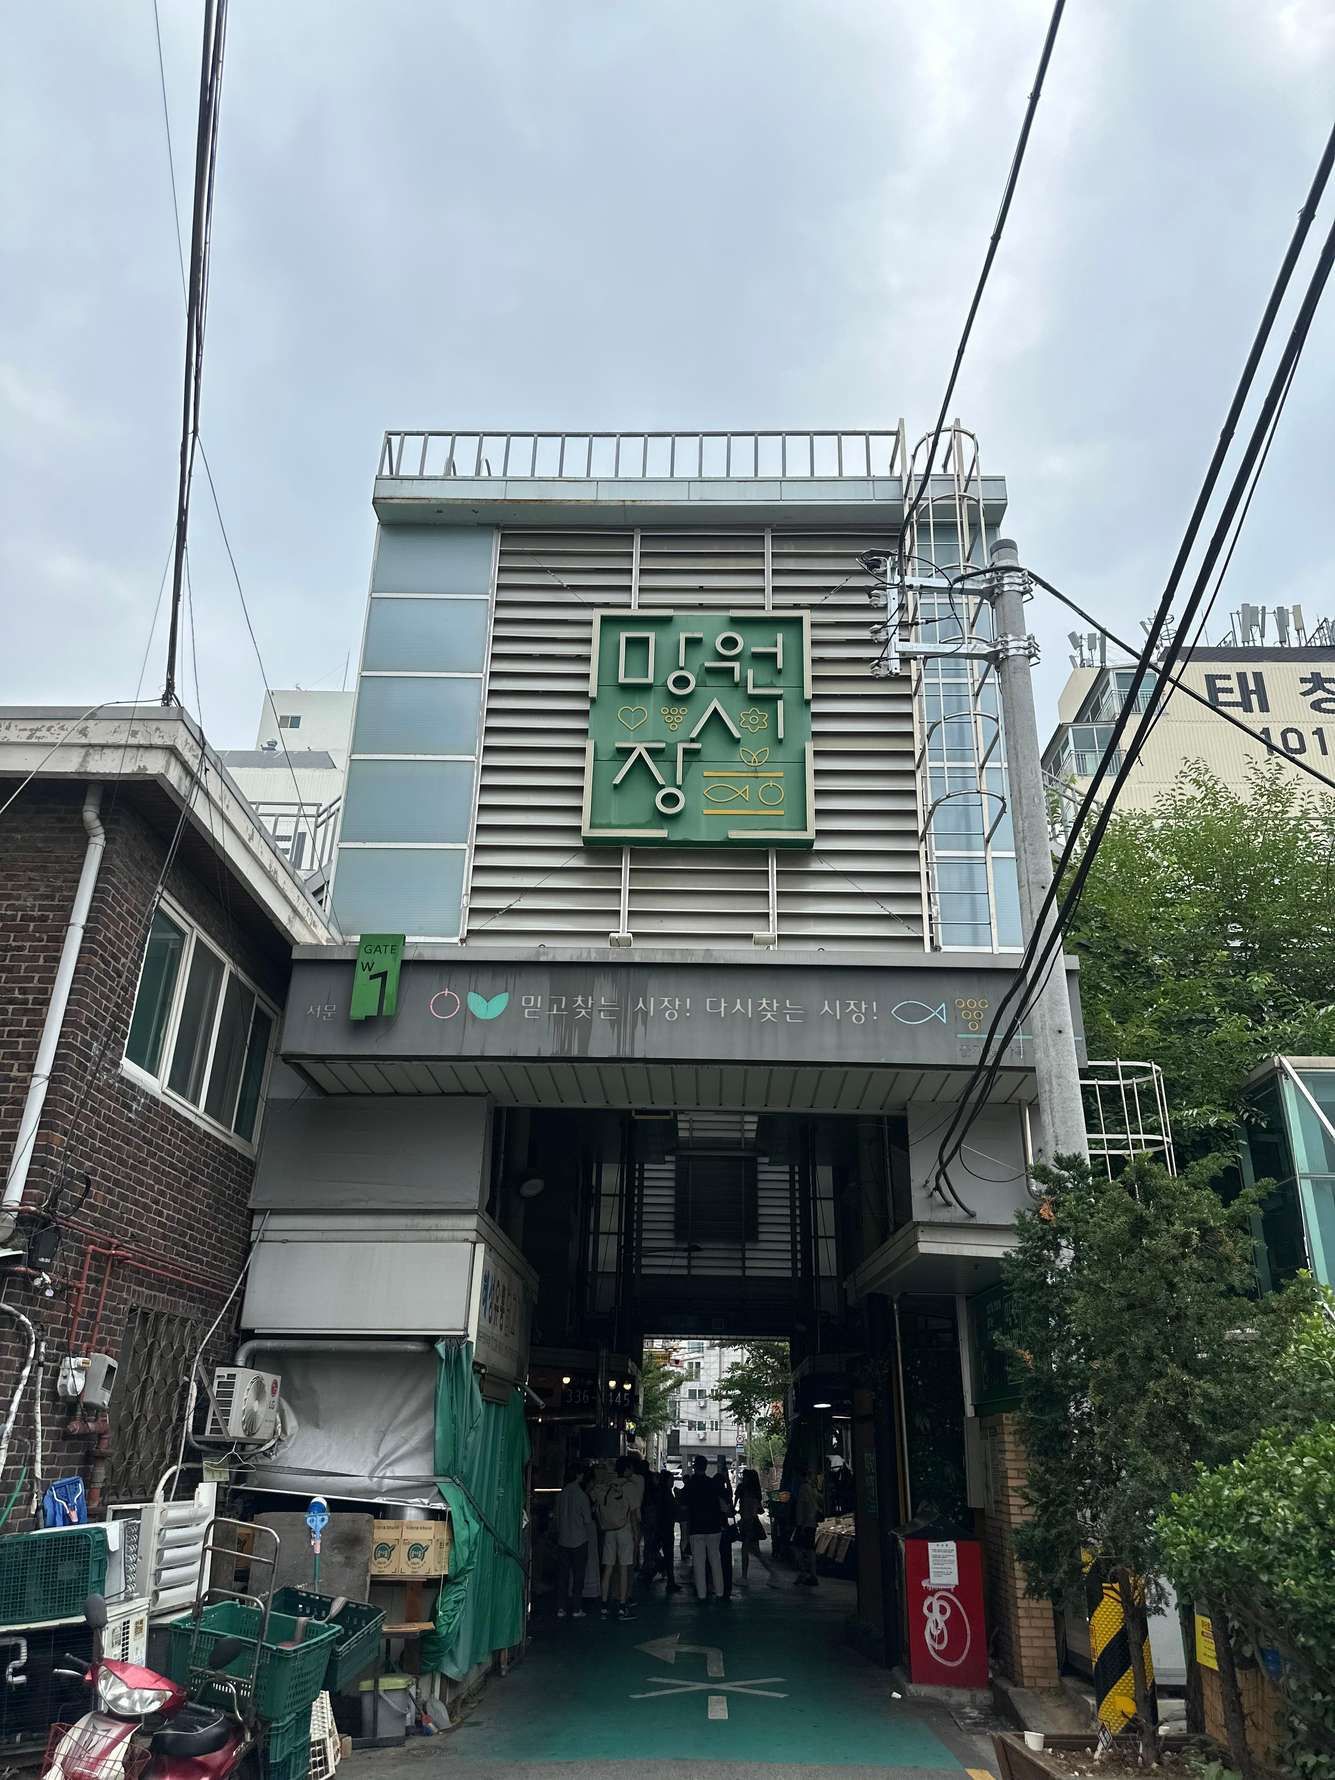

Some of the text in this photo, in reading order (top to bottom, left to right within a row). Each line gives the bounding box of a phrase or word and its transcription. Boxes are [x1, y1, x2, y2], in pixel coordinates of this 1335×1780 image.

[617, 631, 784, 698] 망원
[1259, 727, 1329, 756] 101
[363, 944, 398, 955] GATE
[360, 960, 375, 972] W
[369, 970, 389, 1017] 1
[306, 1003, 337, 1021] 서문
[520, 995, 879, 1025] 믿고찾는 시장! 다시찾는 시장!
